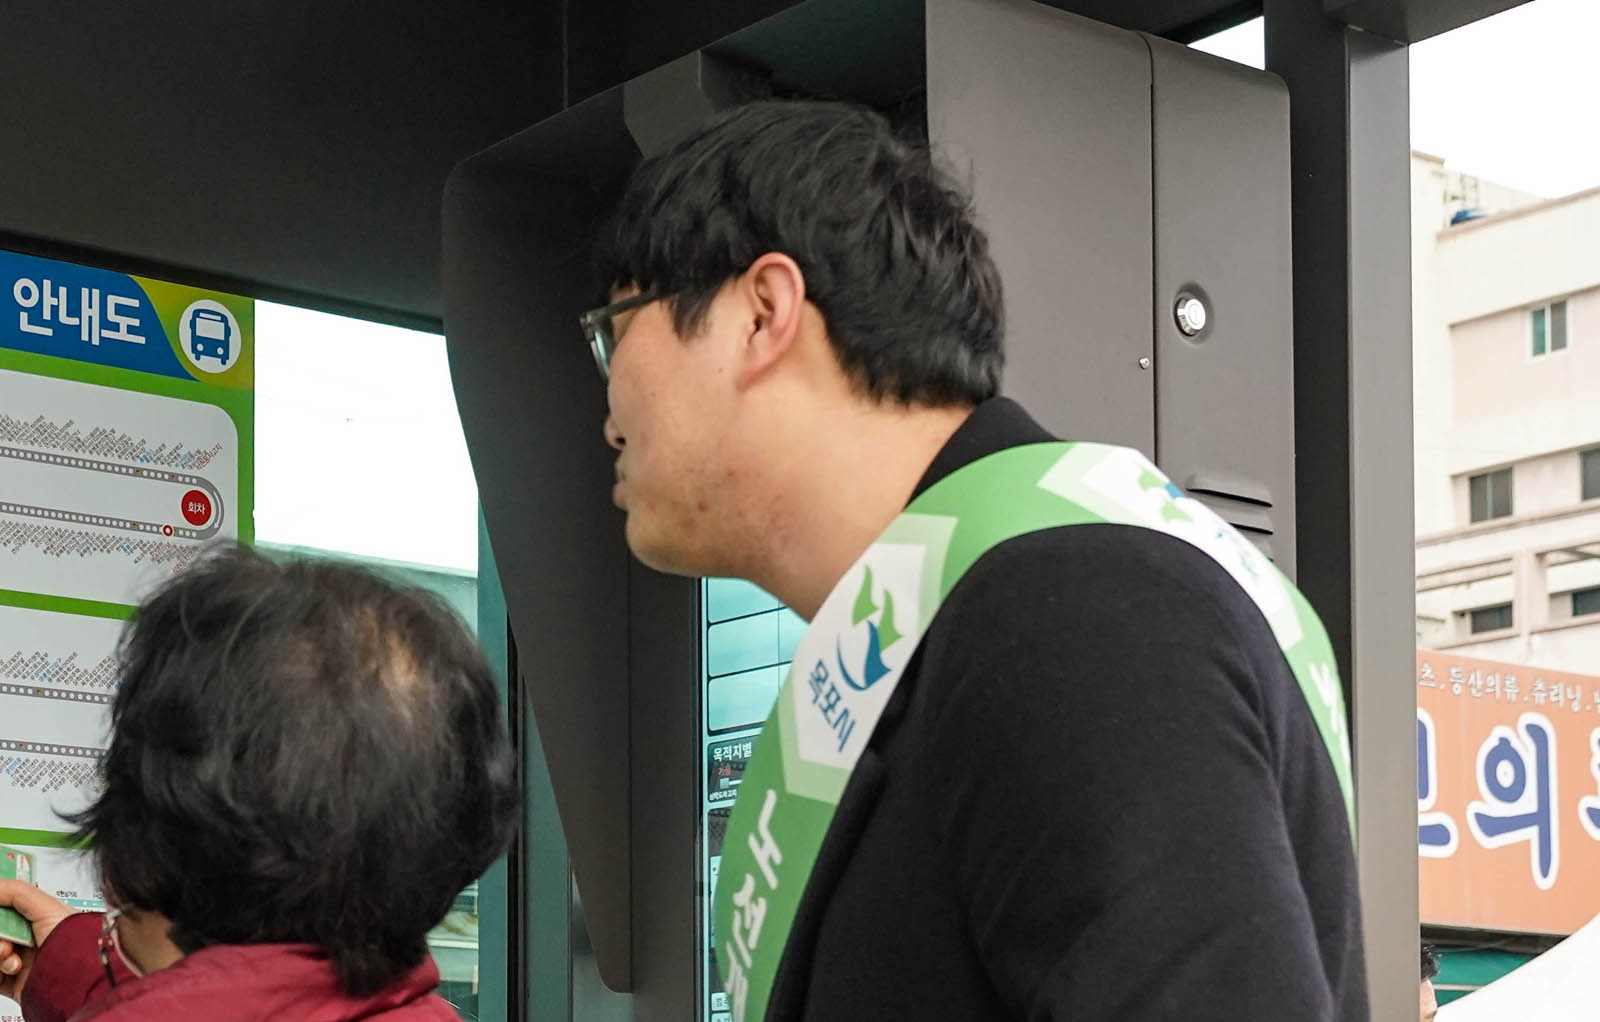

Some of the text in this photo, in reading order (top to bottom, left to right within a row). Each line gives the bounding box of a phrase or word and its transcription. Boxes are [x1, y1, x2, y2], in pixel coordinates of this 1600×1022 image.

[12, 275, 146, 346] 안내도
[186, 501, 206, 516] 회차
[808, 658, 858, 754] 목포시
